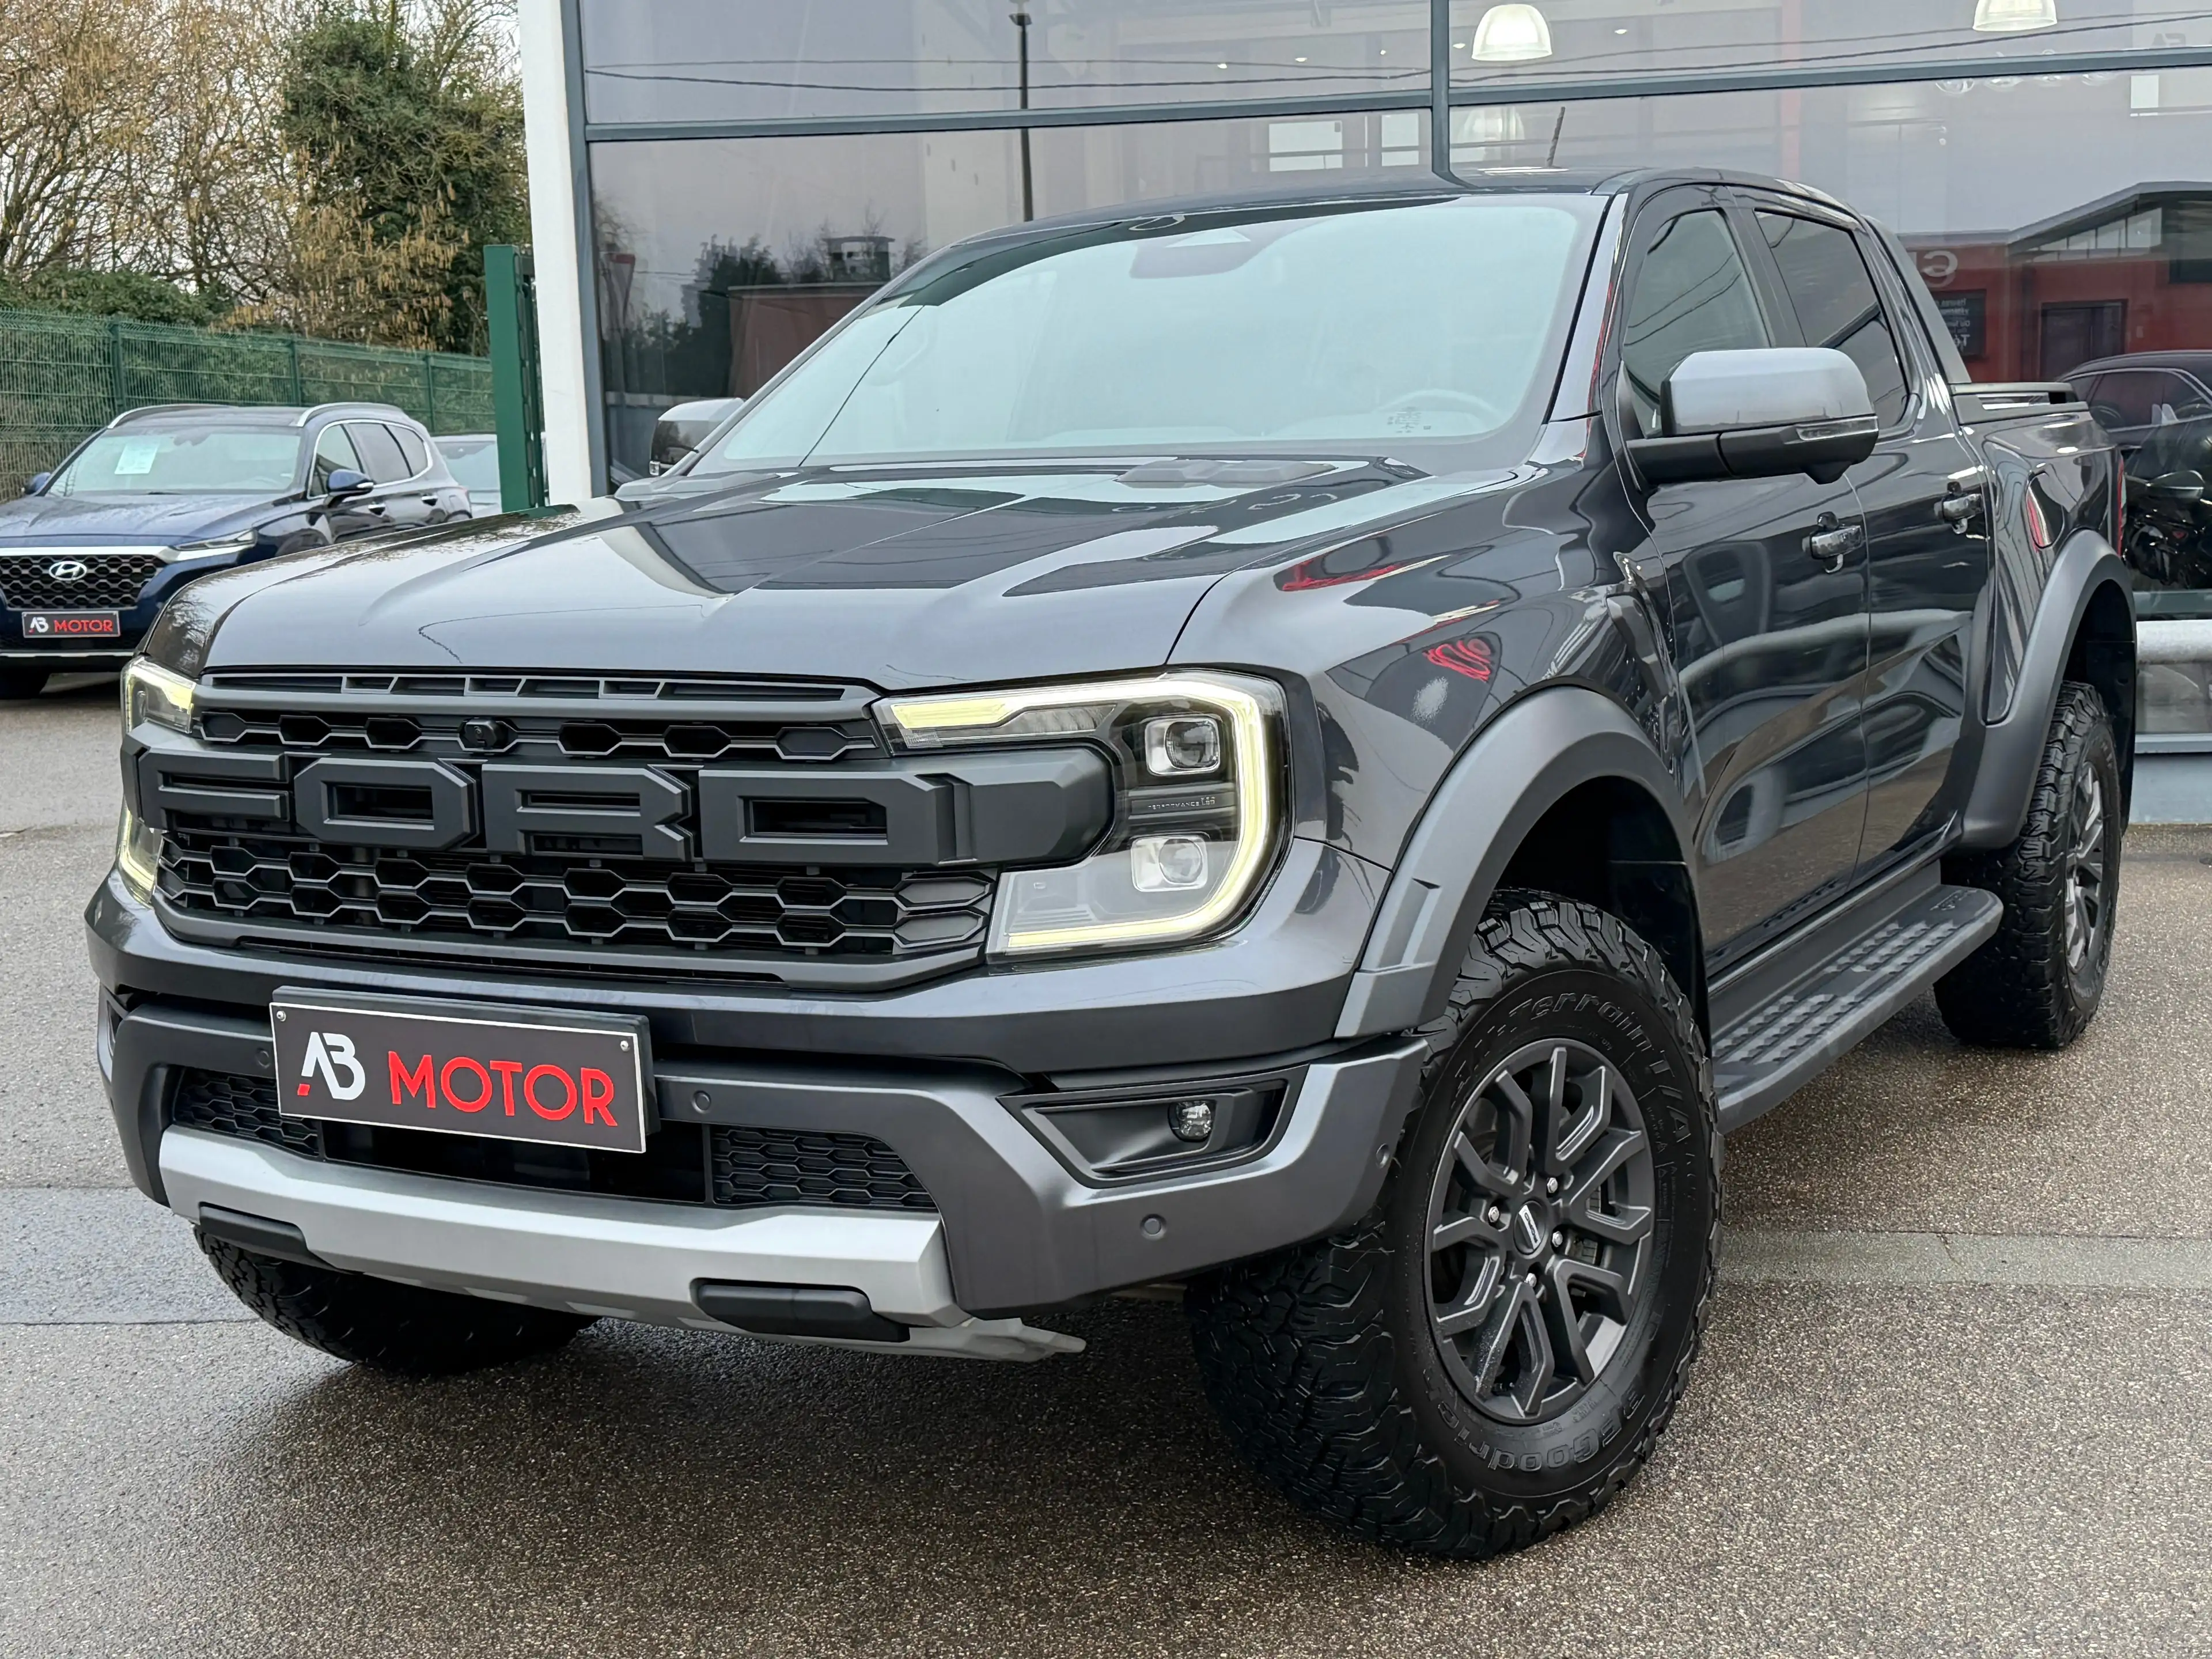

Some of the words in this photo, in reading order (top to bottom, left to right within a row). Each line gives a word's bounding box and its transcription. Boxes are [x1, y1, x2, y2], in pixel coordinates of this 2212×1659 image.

[54, 620, 113, 633] MOTOR
[138, 748, 957, 865] FORD
[297, 1032, 366, 1100] AB
[388, 1051, 618, 1127] MOTOR
